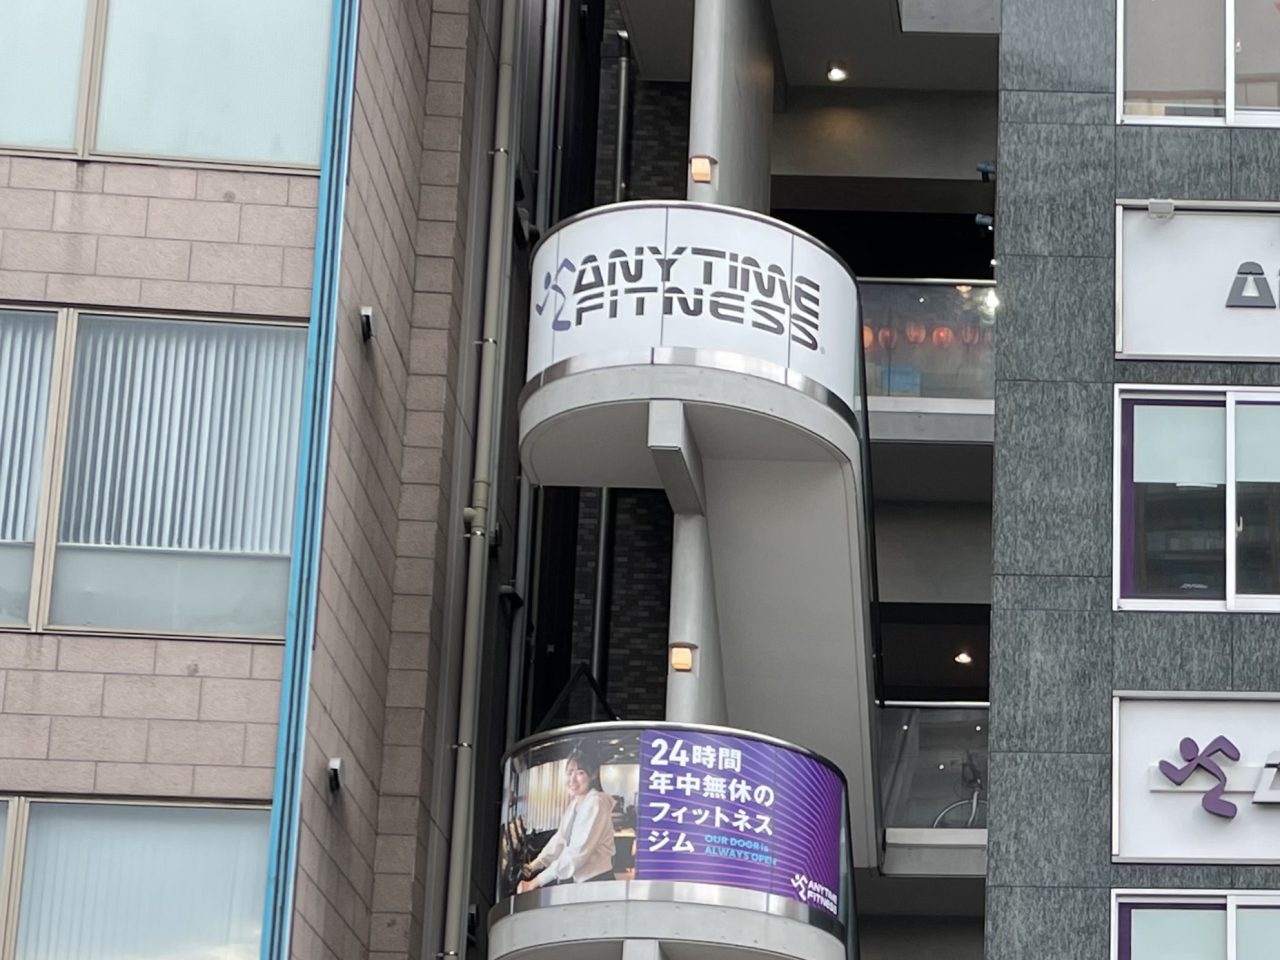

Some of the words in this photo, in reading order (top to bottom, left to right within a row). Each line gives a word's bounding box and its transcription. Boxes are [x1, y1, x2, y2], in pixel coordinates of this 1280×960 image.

[573, 246, 820, 321] ANYTIME
[574, 286, 818, 351] FITNESS
[651, 738, 742, 773] 24時間
[648, 770, 775, 808] 年中無休の
[648, 801, 773, 836] フィットネス
[648, 829, 695, 854] ジム
[704, 834, 727, 845] OUR
[729, 835, 760, 851] DOOR
[704, 845, 751, 861] ALWAYS
[807, 881, 837, 906] ANYTIME
[807, 890, 837, 915] FITNESS
